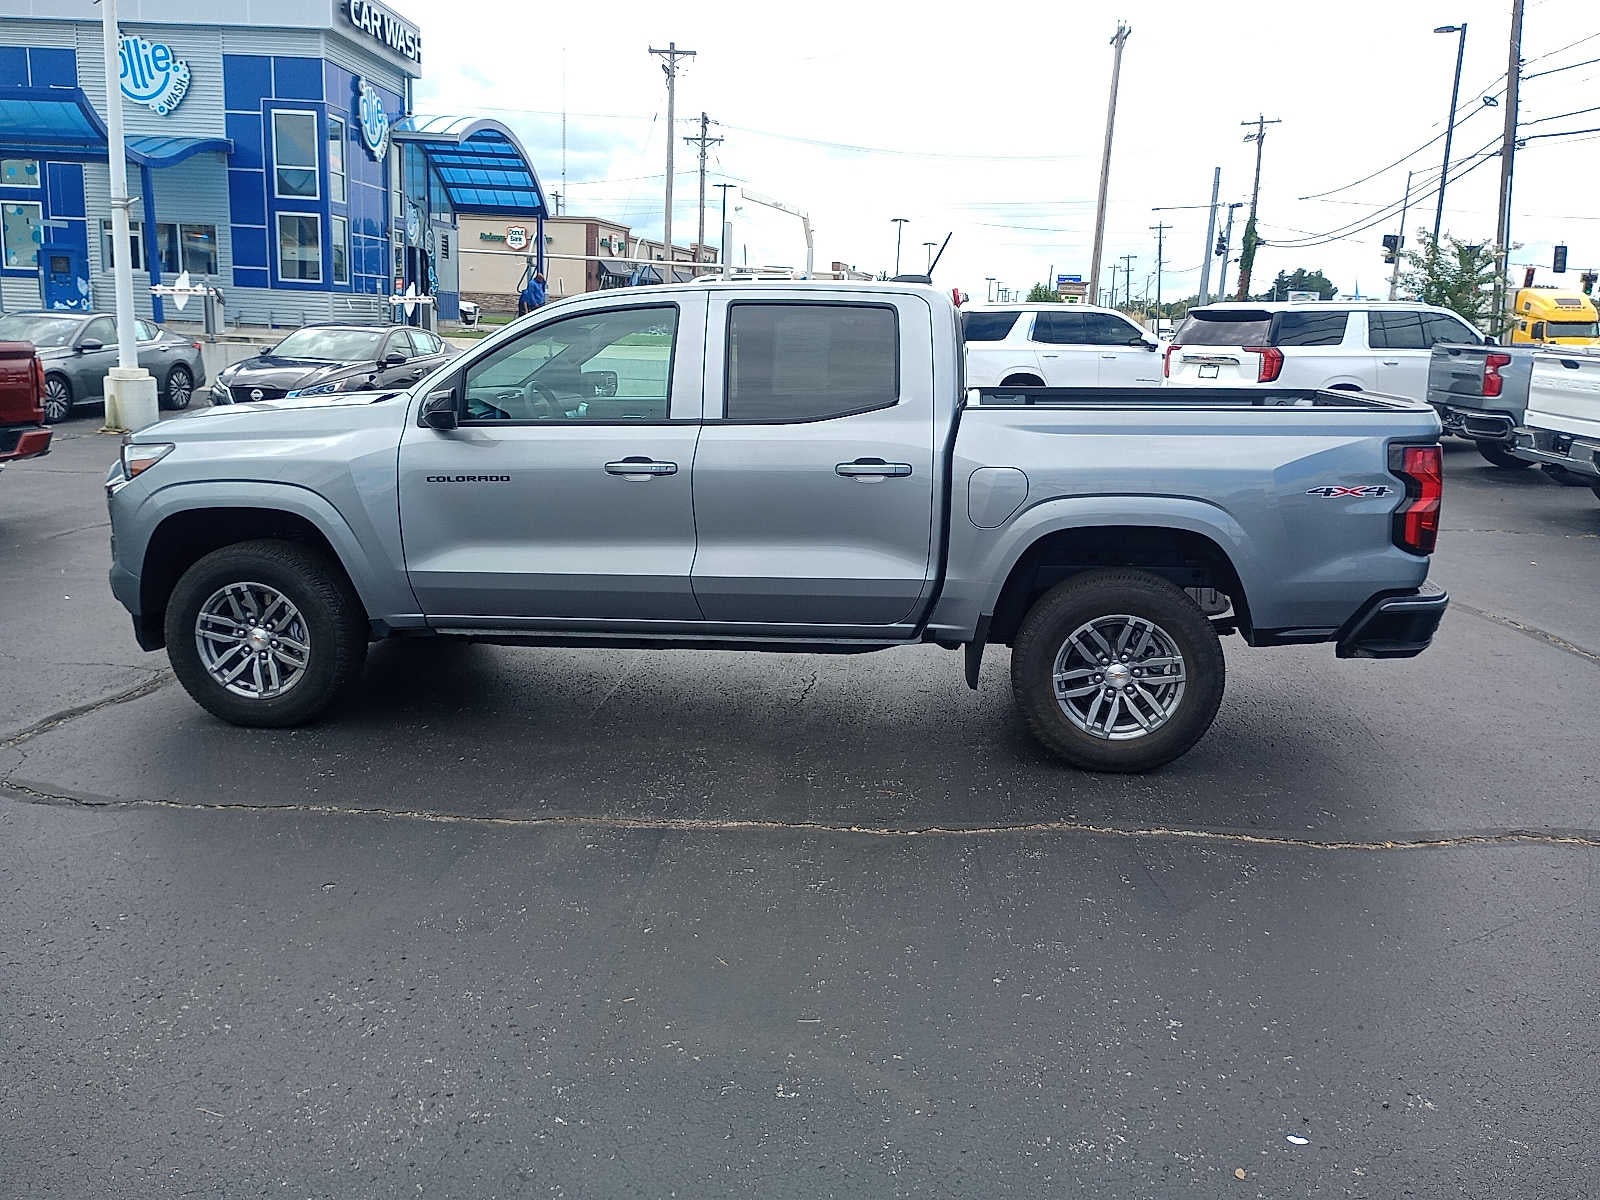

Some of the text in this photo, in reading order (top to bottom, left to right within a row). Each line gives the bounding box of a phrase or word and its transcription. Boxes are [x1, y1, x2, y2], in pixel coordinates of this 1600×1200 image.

[350, 0, 423, 64] CAR WASH
[163, 78, 187, 108] WASH
